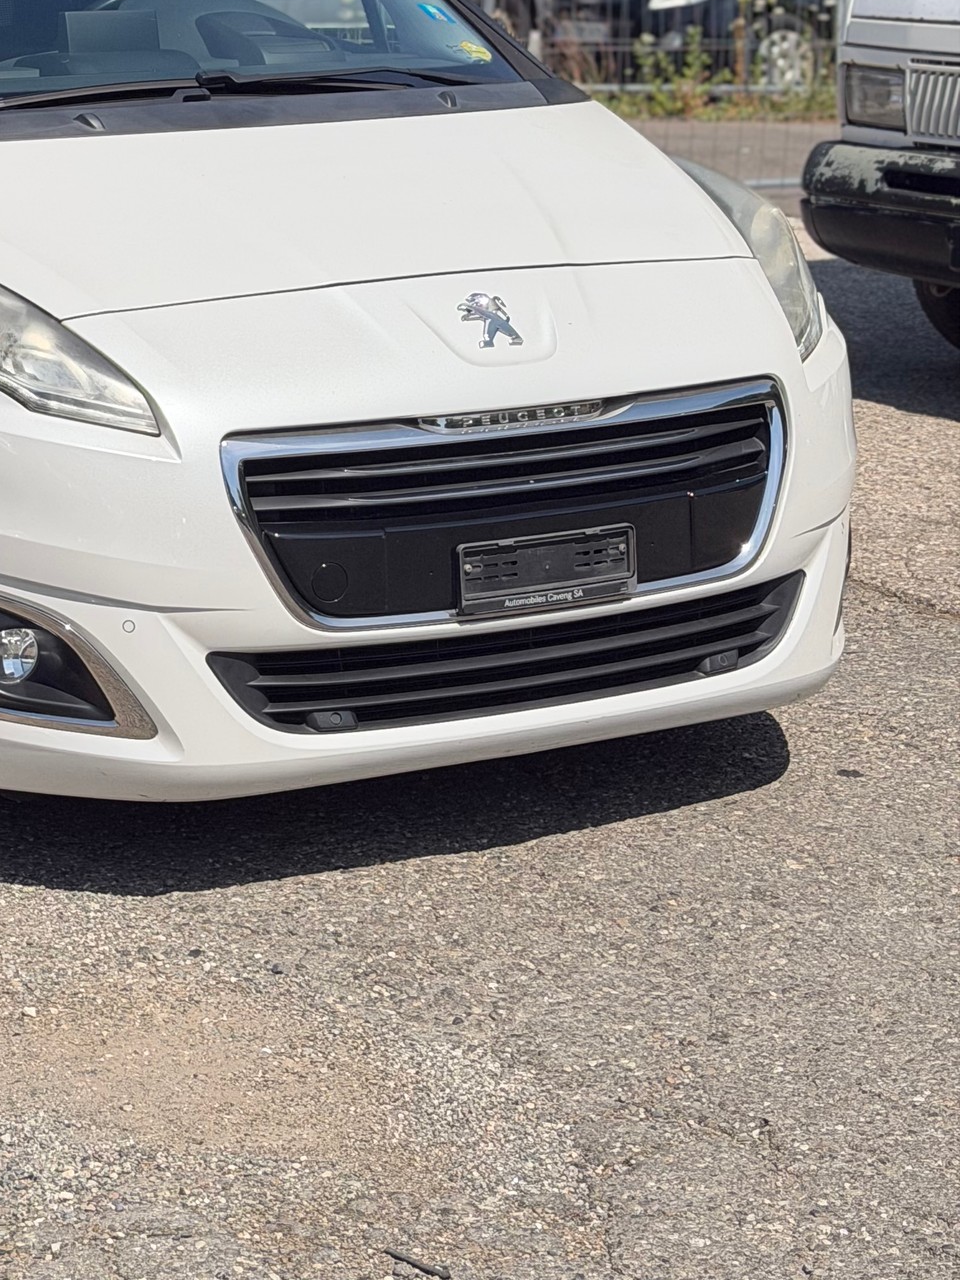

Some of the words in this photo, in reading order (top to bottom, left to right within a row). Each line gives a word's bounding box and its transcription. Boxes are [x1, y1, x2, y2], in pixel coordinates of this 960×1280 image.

[462, 405, 581, 427] PEUGEOT
[504, 596, 546, 607] Automobiles
[547, 592, 572, 601] Caveng
[573, 589, 584, 598] SA
